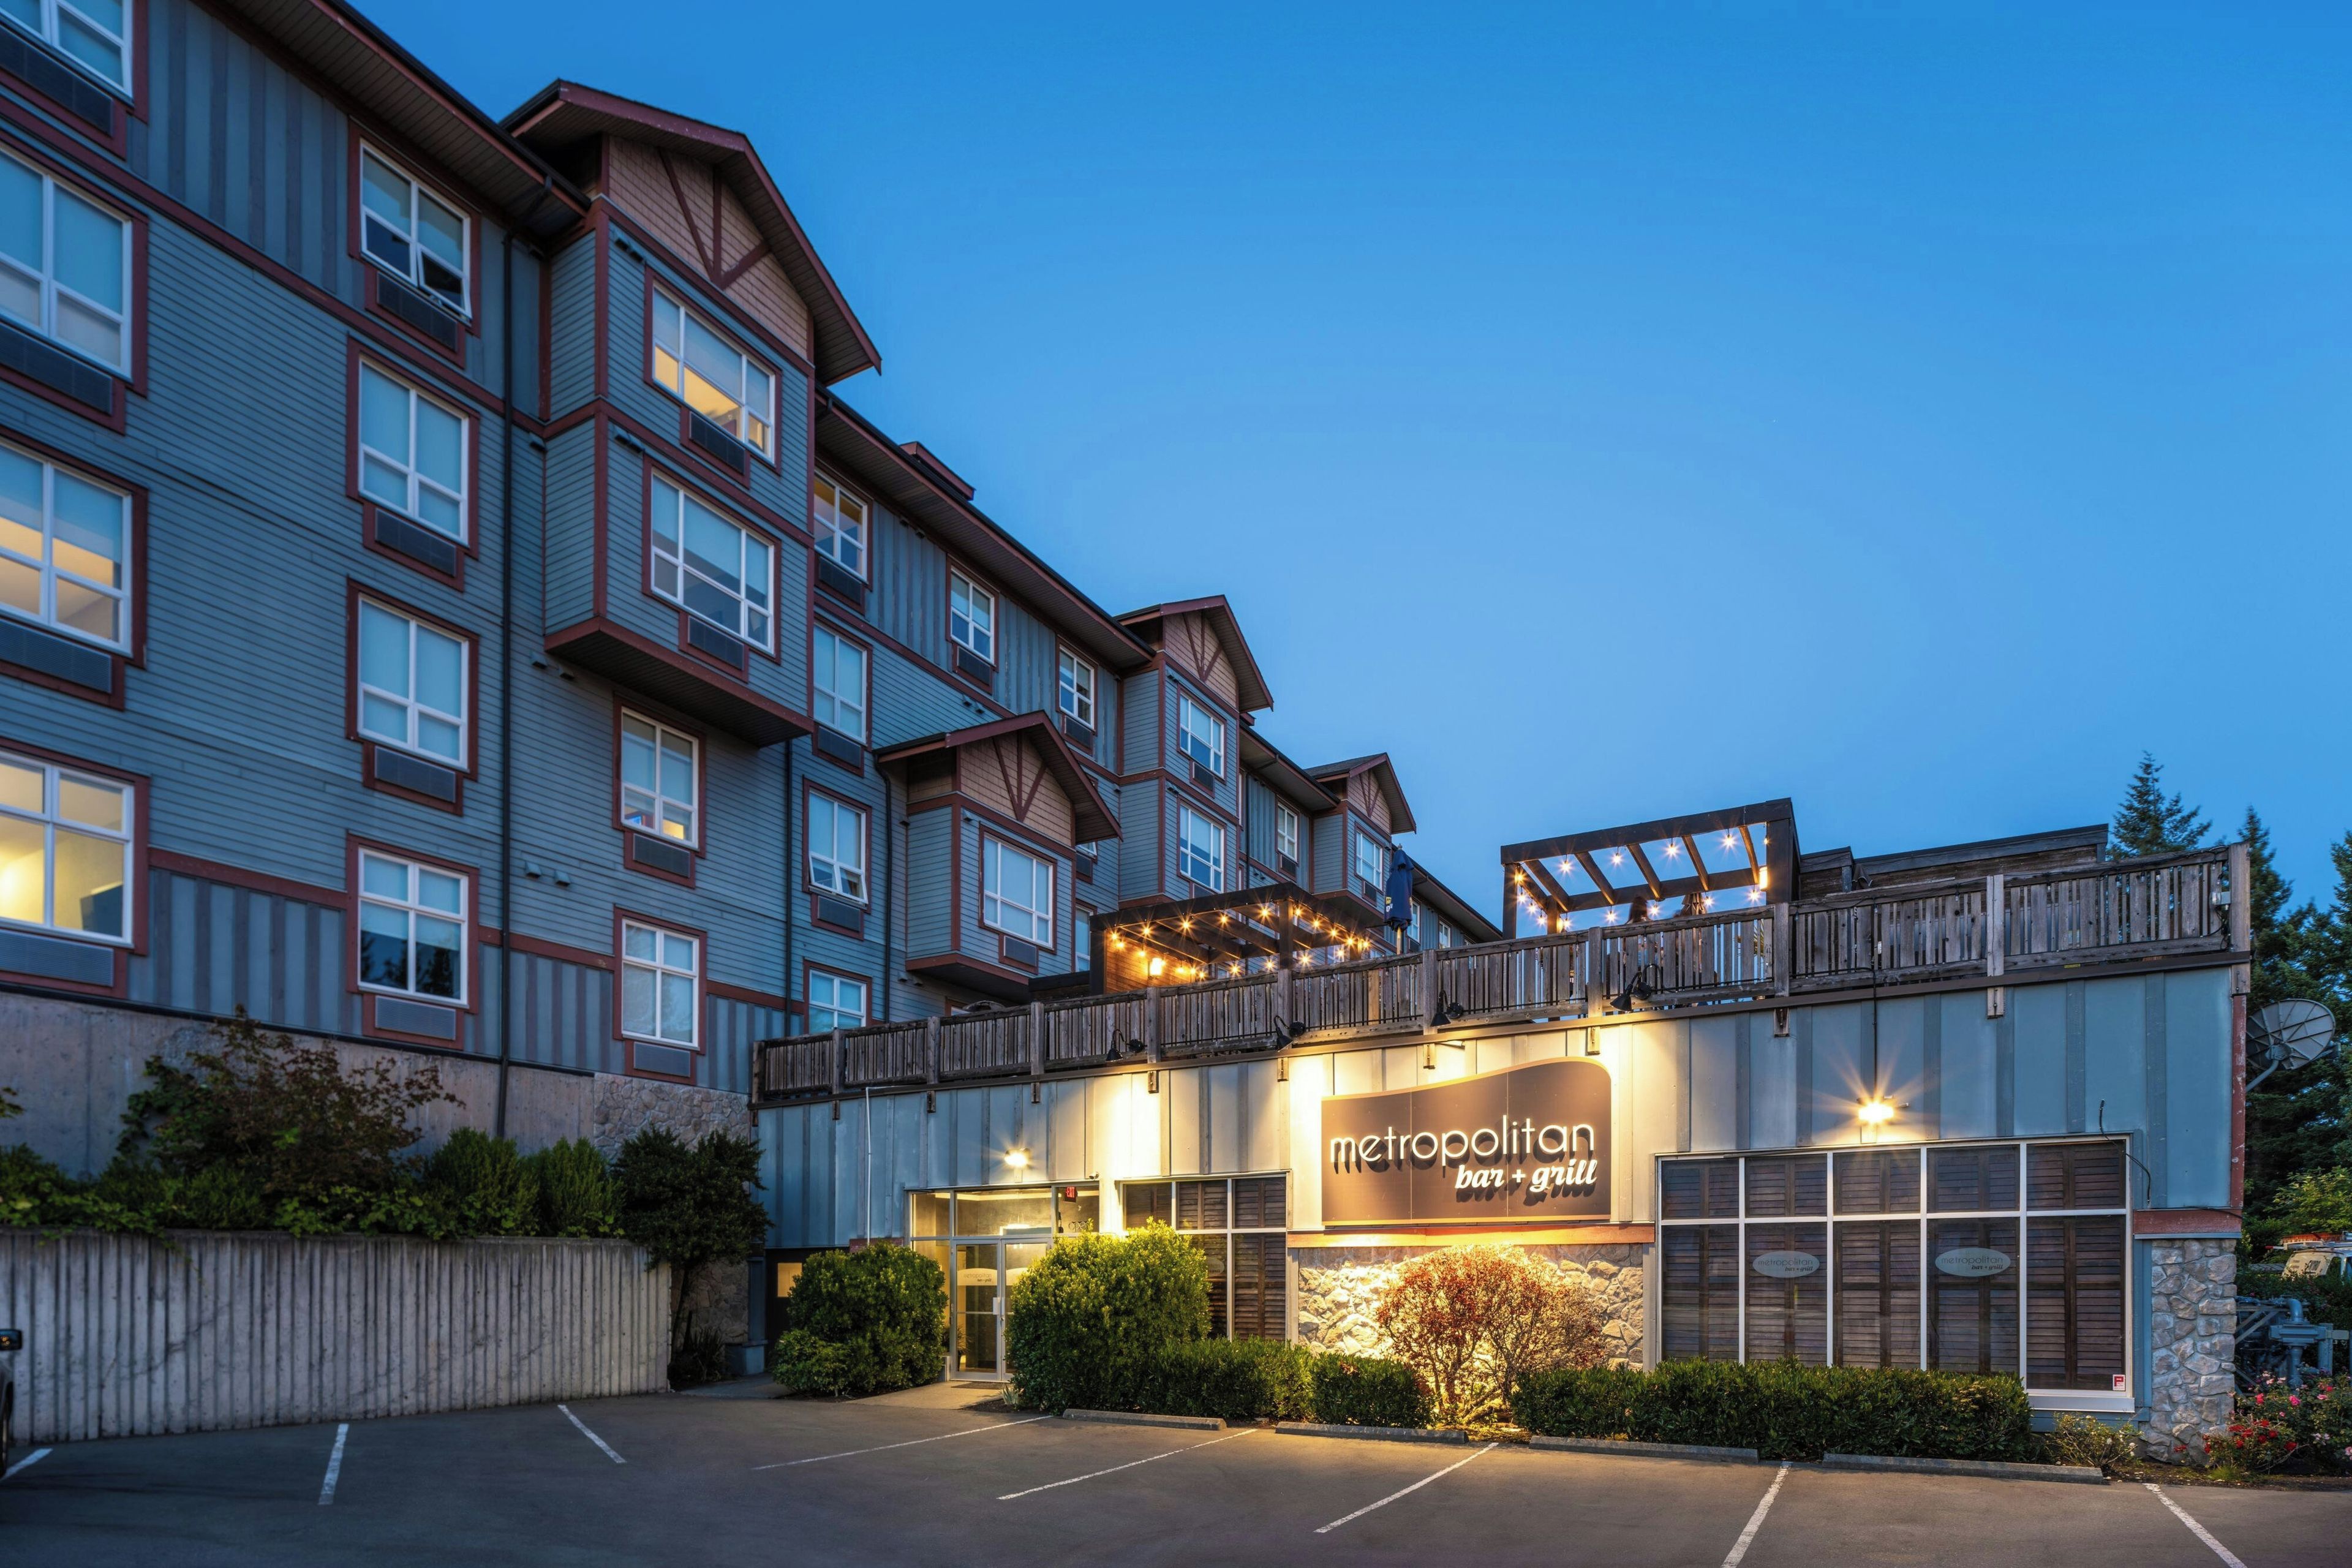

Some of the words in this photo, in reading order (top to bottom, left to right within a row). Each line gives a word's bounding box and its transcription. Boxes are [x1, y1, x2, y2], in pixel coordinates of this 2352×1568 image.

[1330, 1114, 1595, 1167] metropolitan
[1454, 1164, 1506, 1189] bar
[1512, 1169, 1526, 1183] +
[1529, 1158, 1598, 1193] grill
